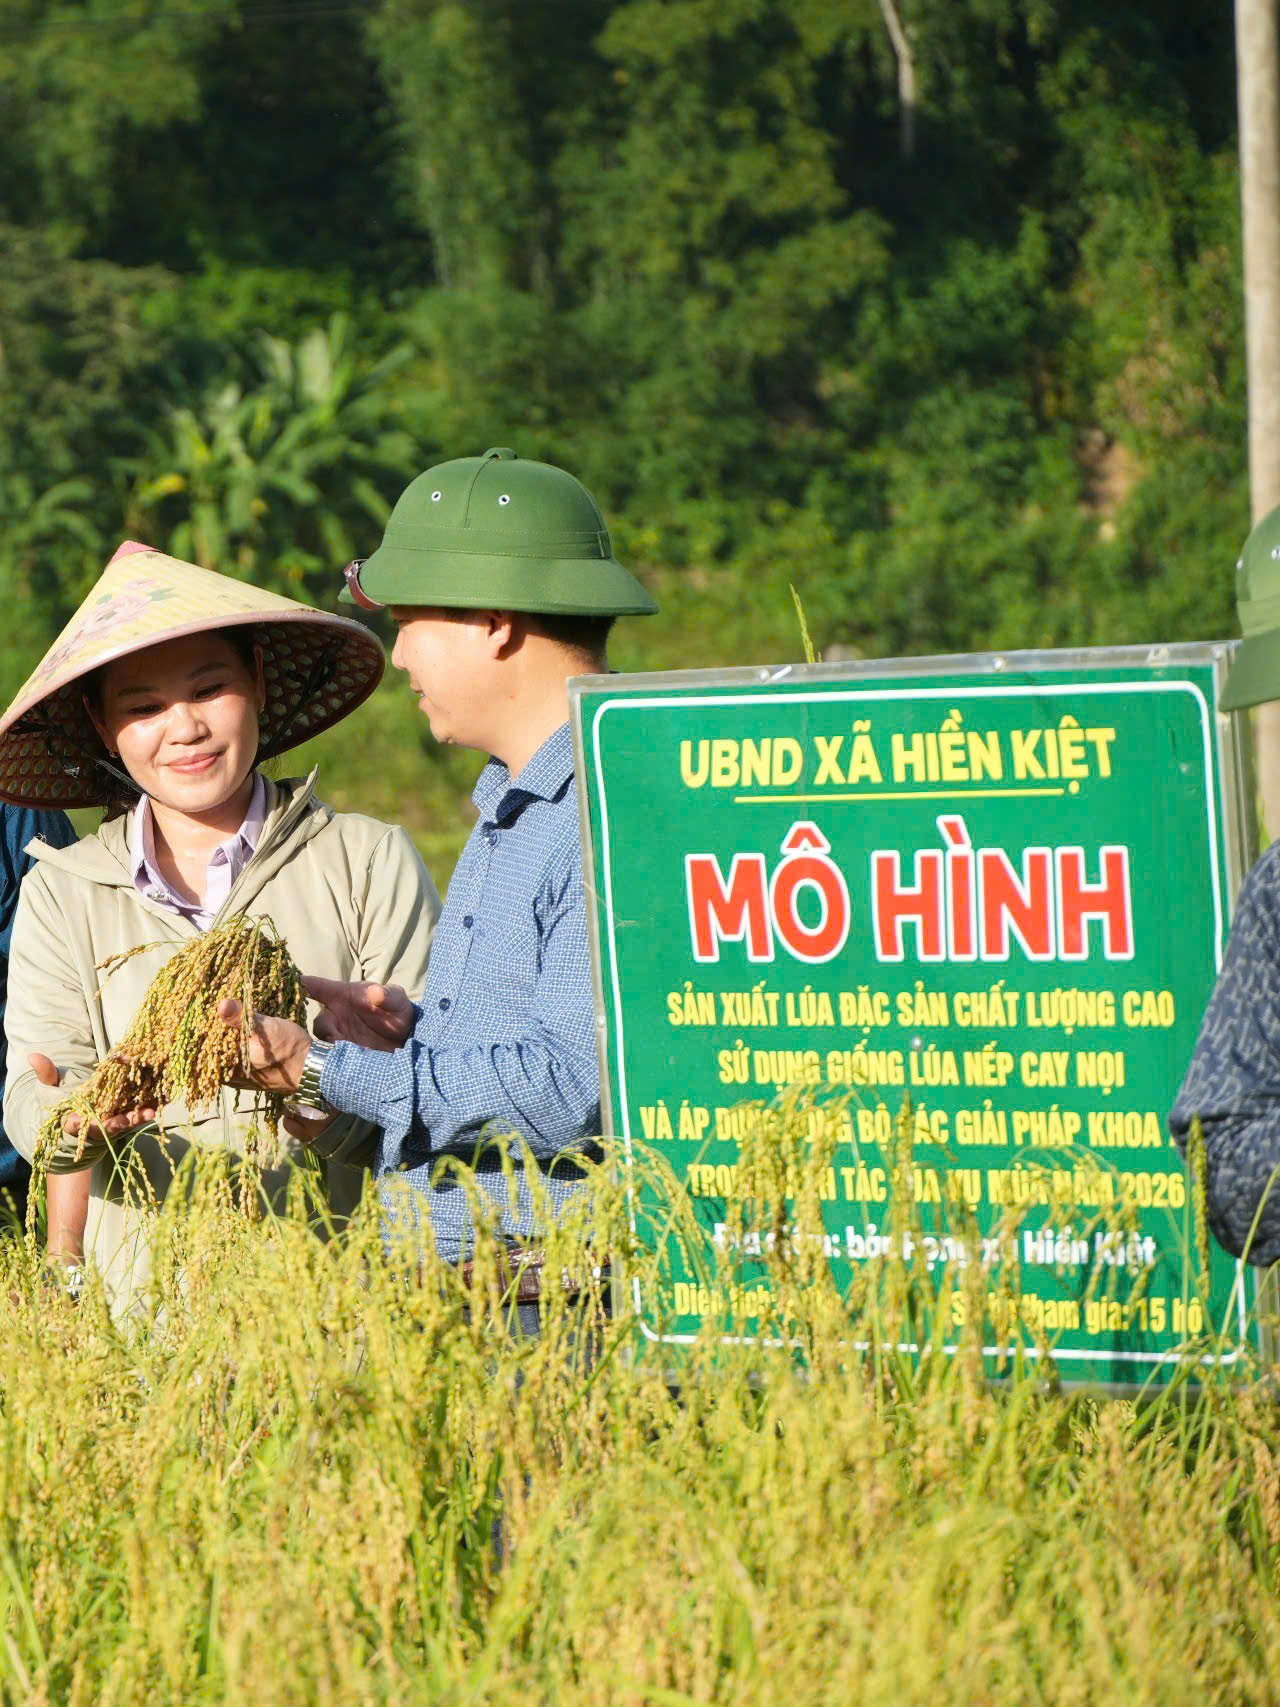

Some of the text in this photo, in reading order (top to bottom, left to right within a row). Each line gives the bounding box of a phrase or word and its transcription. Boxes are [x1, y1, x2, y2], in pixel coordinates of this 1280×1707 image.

[680, 709, 1117, 795] UBND XÃ HIỀN KIỆT
[684, 814, 1135, 964] MÔ HÌNH
[667, 978, 1176, 1035] SẢN XUẤT LÚA ĐẶC SẢN CHẤT LƯỢNG CAO
[717, 1038, 1125, 1096] SỬ DỤNG GIỐNG LÚA NẾP CAY NỌI
[639, 1099, 674, 1141] VÀ
[678, 1099, 710, 1141] ÁP
[856, 1102, 892, 1151] BỘ
[897, 1102, 949, 1146] ÁC
[955, 1098, 1009, 1146] GIẢI
[1011, 1103, 1082, 1147] PHÁP
[1087, 1111, 1162, 1148] KHOA
[840, 1160, 887, 1202] TÁC
[1119, 1171, 1186, 1208] 2026
[1085, 1295, 1130, 1335] gia:
[1134, 1297, 1167, 1333] 15
